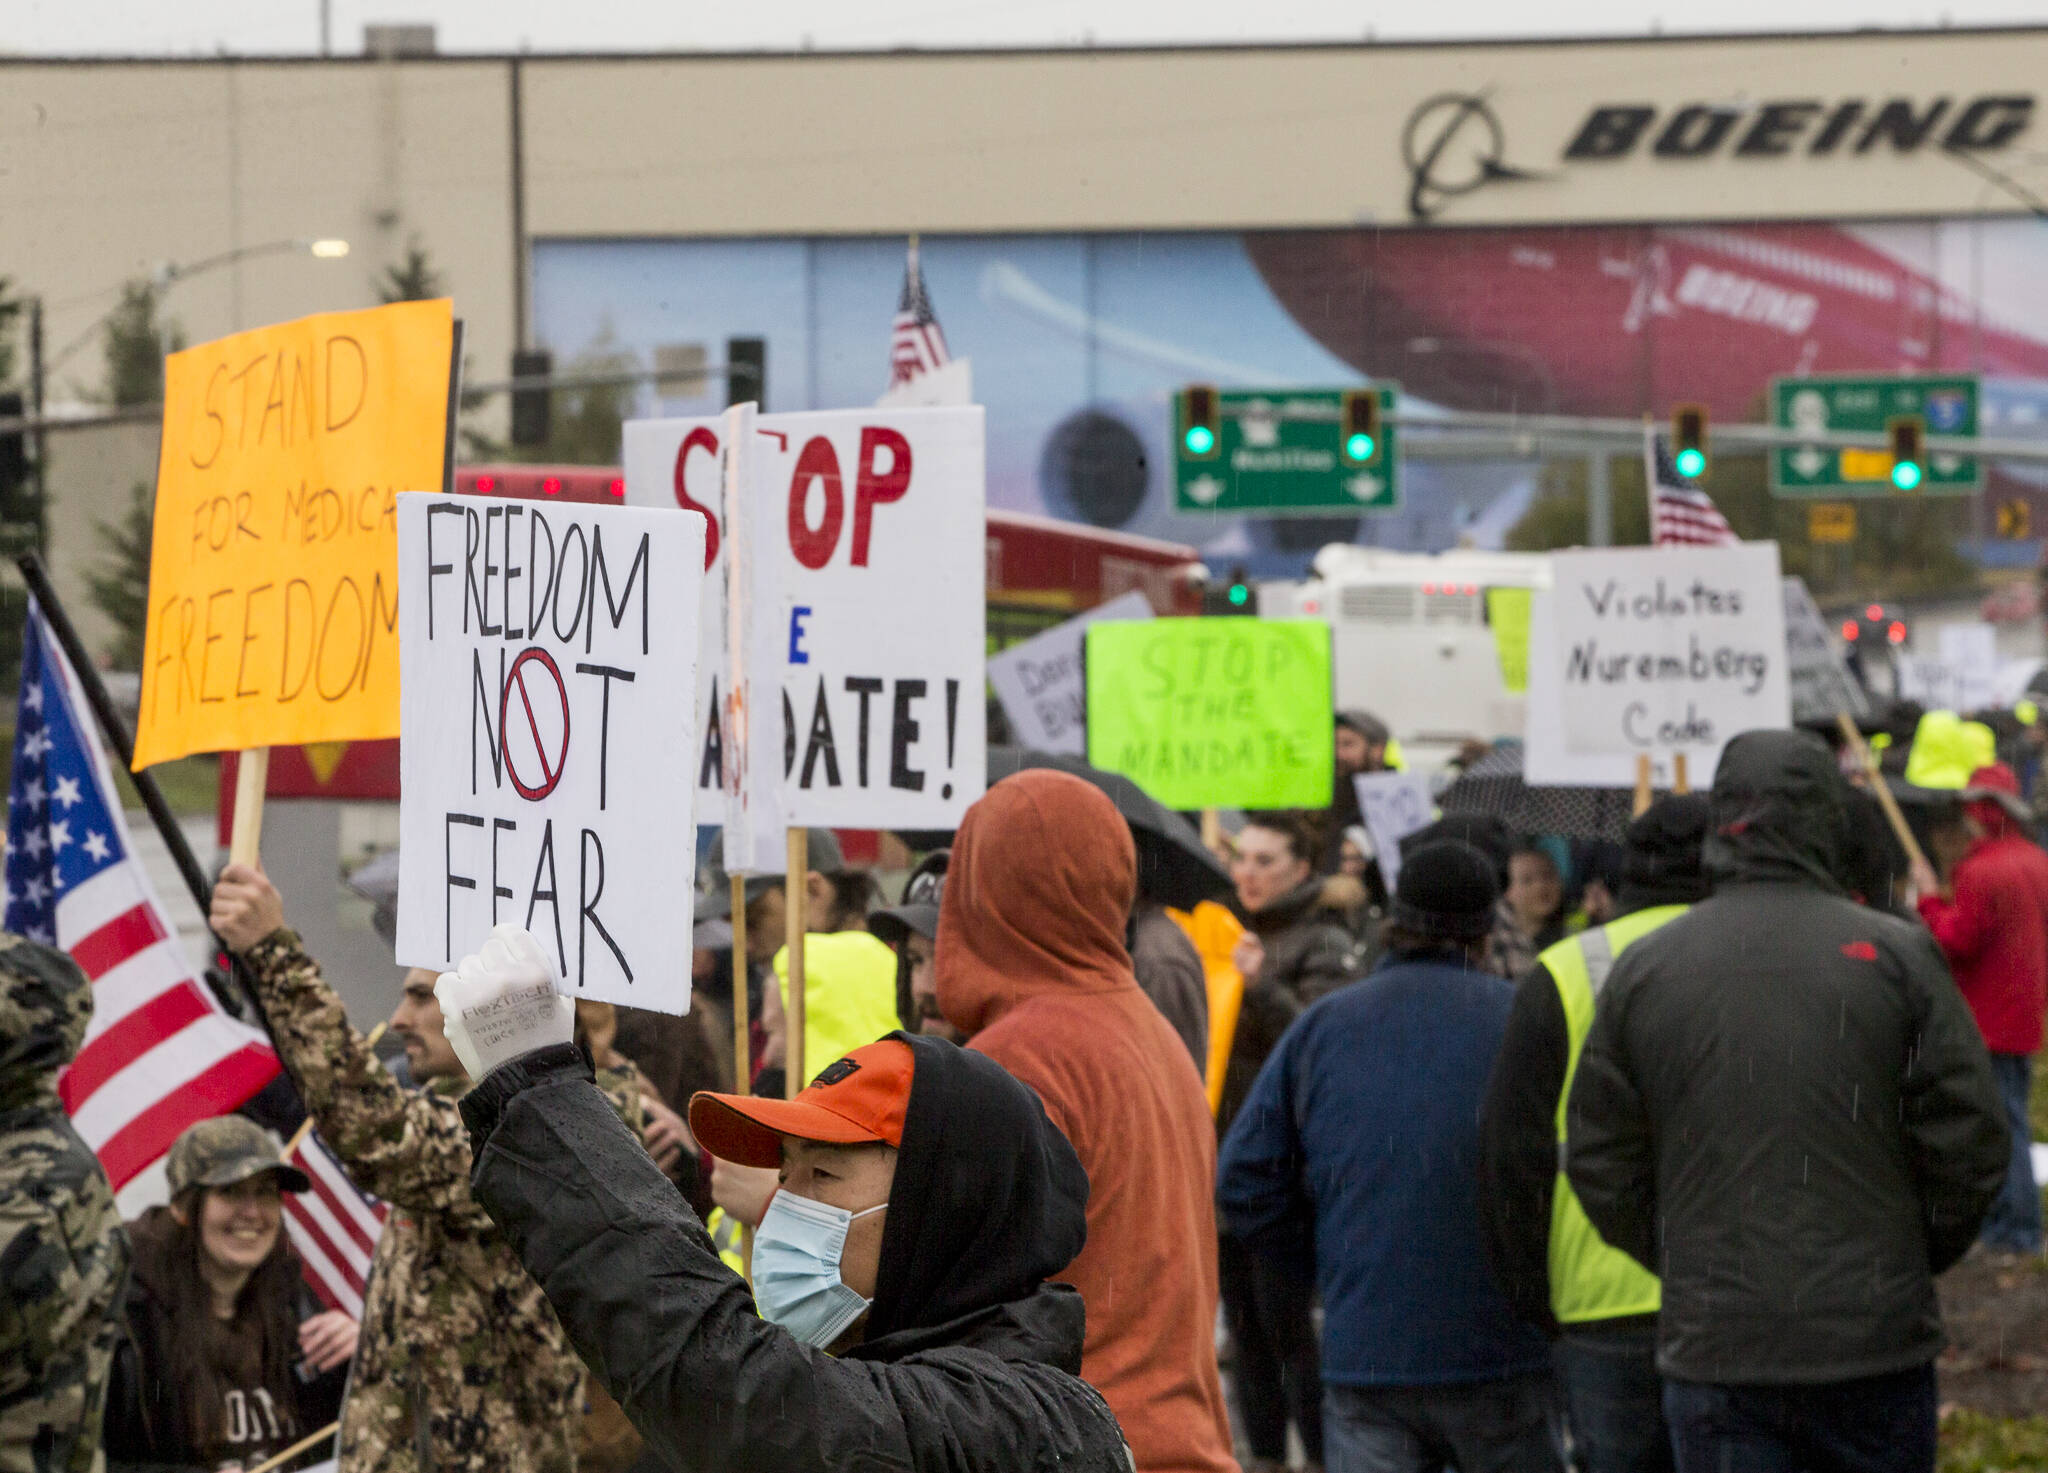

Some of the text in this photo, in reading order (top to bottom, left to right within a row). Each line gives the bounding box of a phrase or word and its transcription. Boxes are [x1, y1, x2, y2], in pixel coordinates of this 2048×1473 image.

[1563, 96, 2035, 161] BOEING
[190, 334, 369, 471] STAND
[191, 478, 409, 567] FOR MEDICA
[673, 426, 912, 572] SOP
[427, 502, 649, 655] FREEDOM
[1582, 575, 1743, 619] Violates
[1141, 634, 1294, 700] STOP
[1565, 632, 1768, 695] Nuremberg
[472, 646, 635, 812] NOT
[1175, 688, 1256, 723] THE
[1621, 699, 1718, 747] Code
[1121, 728, 1313, 780] MANDATE
[445, 812, 634, 987] FEAR
